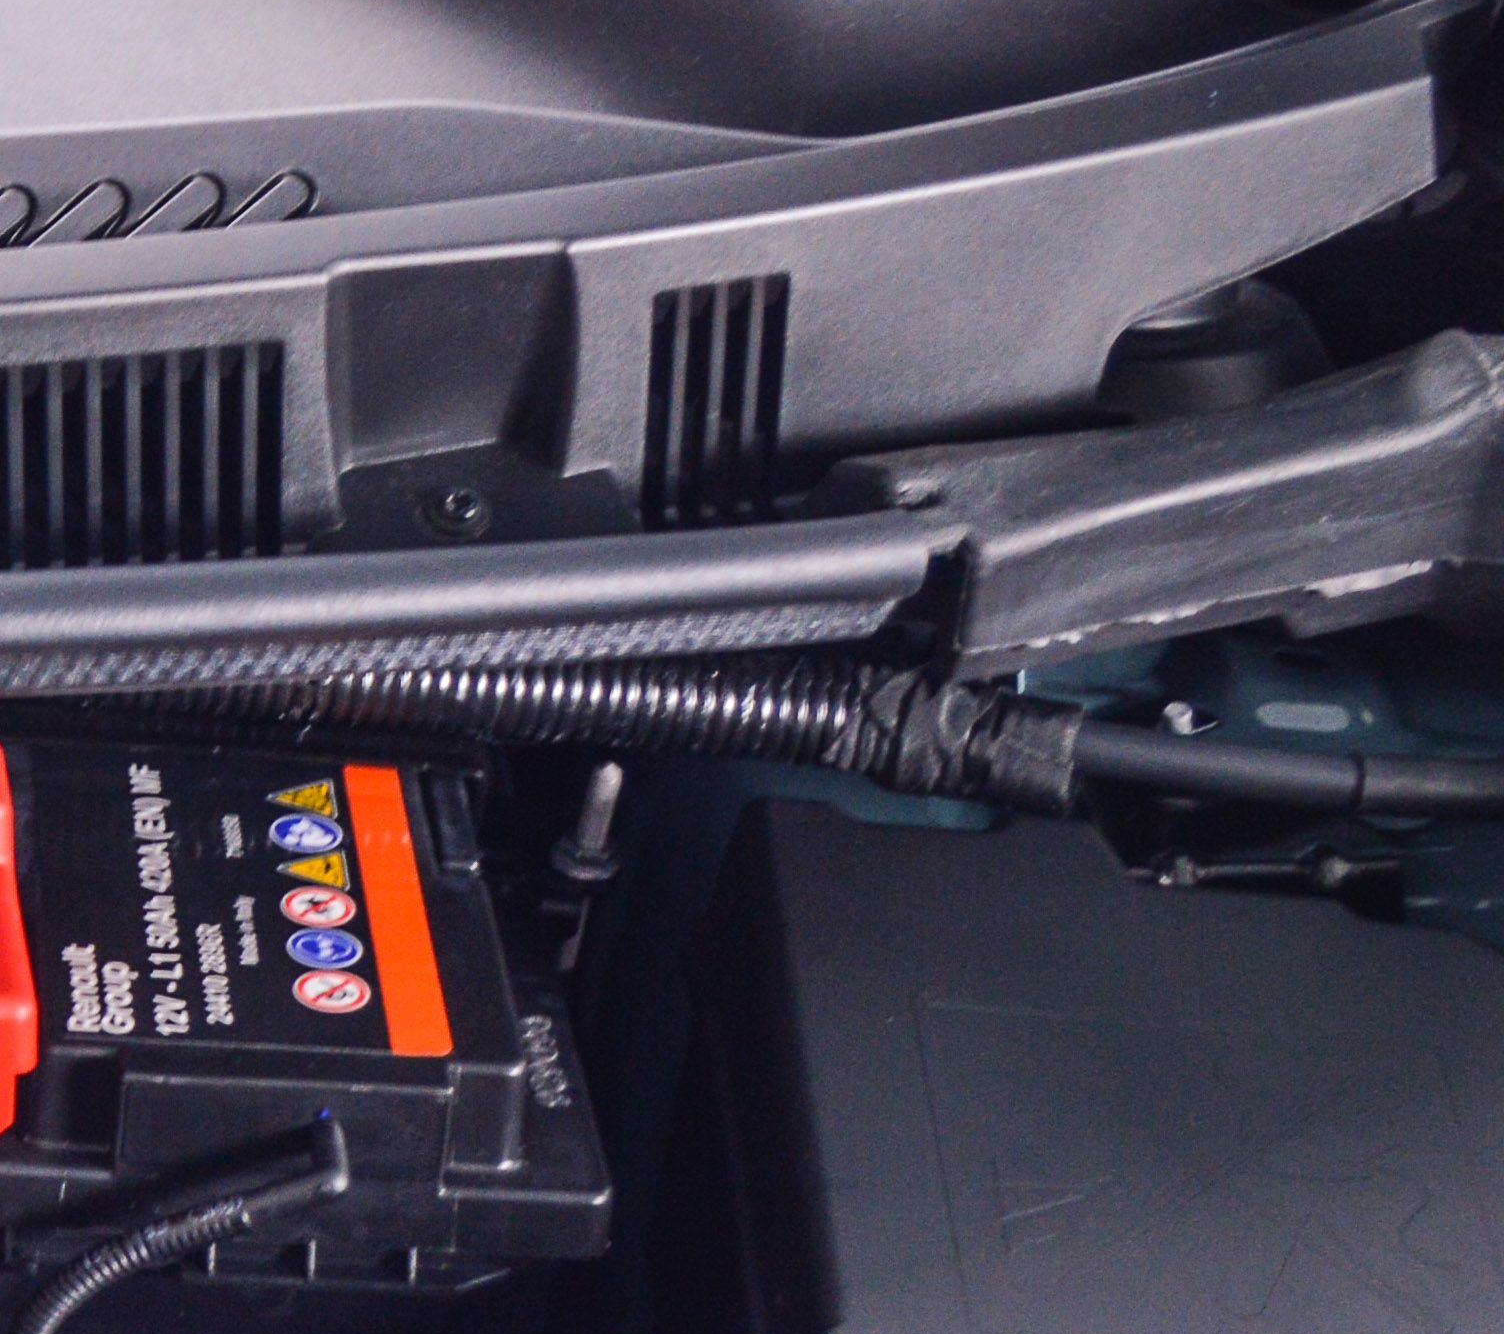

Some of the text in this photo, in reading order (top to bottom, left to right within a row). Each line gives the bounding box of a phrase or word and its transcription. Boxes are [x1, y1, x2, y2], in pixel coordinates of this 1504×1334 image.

[132, 797, 175, 841] (EN)
[137, 842, 173, 893] 420A
[142, 895, 181, 949] 50Ah
[62, 943, 101, 1033] Renault
[148, 952, 184, 980] L1
[101, 961, 139, 1034] Group
[152, 994, 190, 1036] 12V
